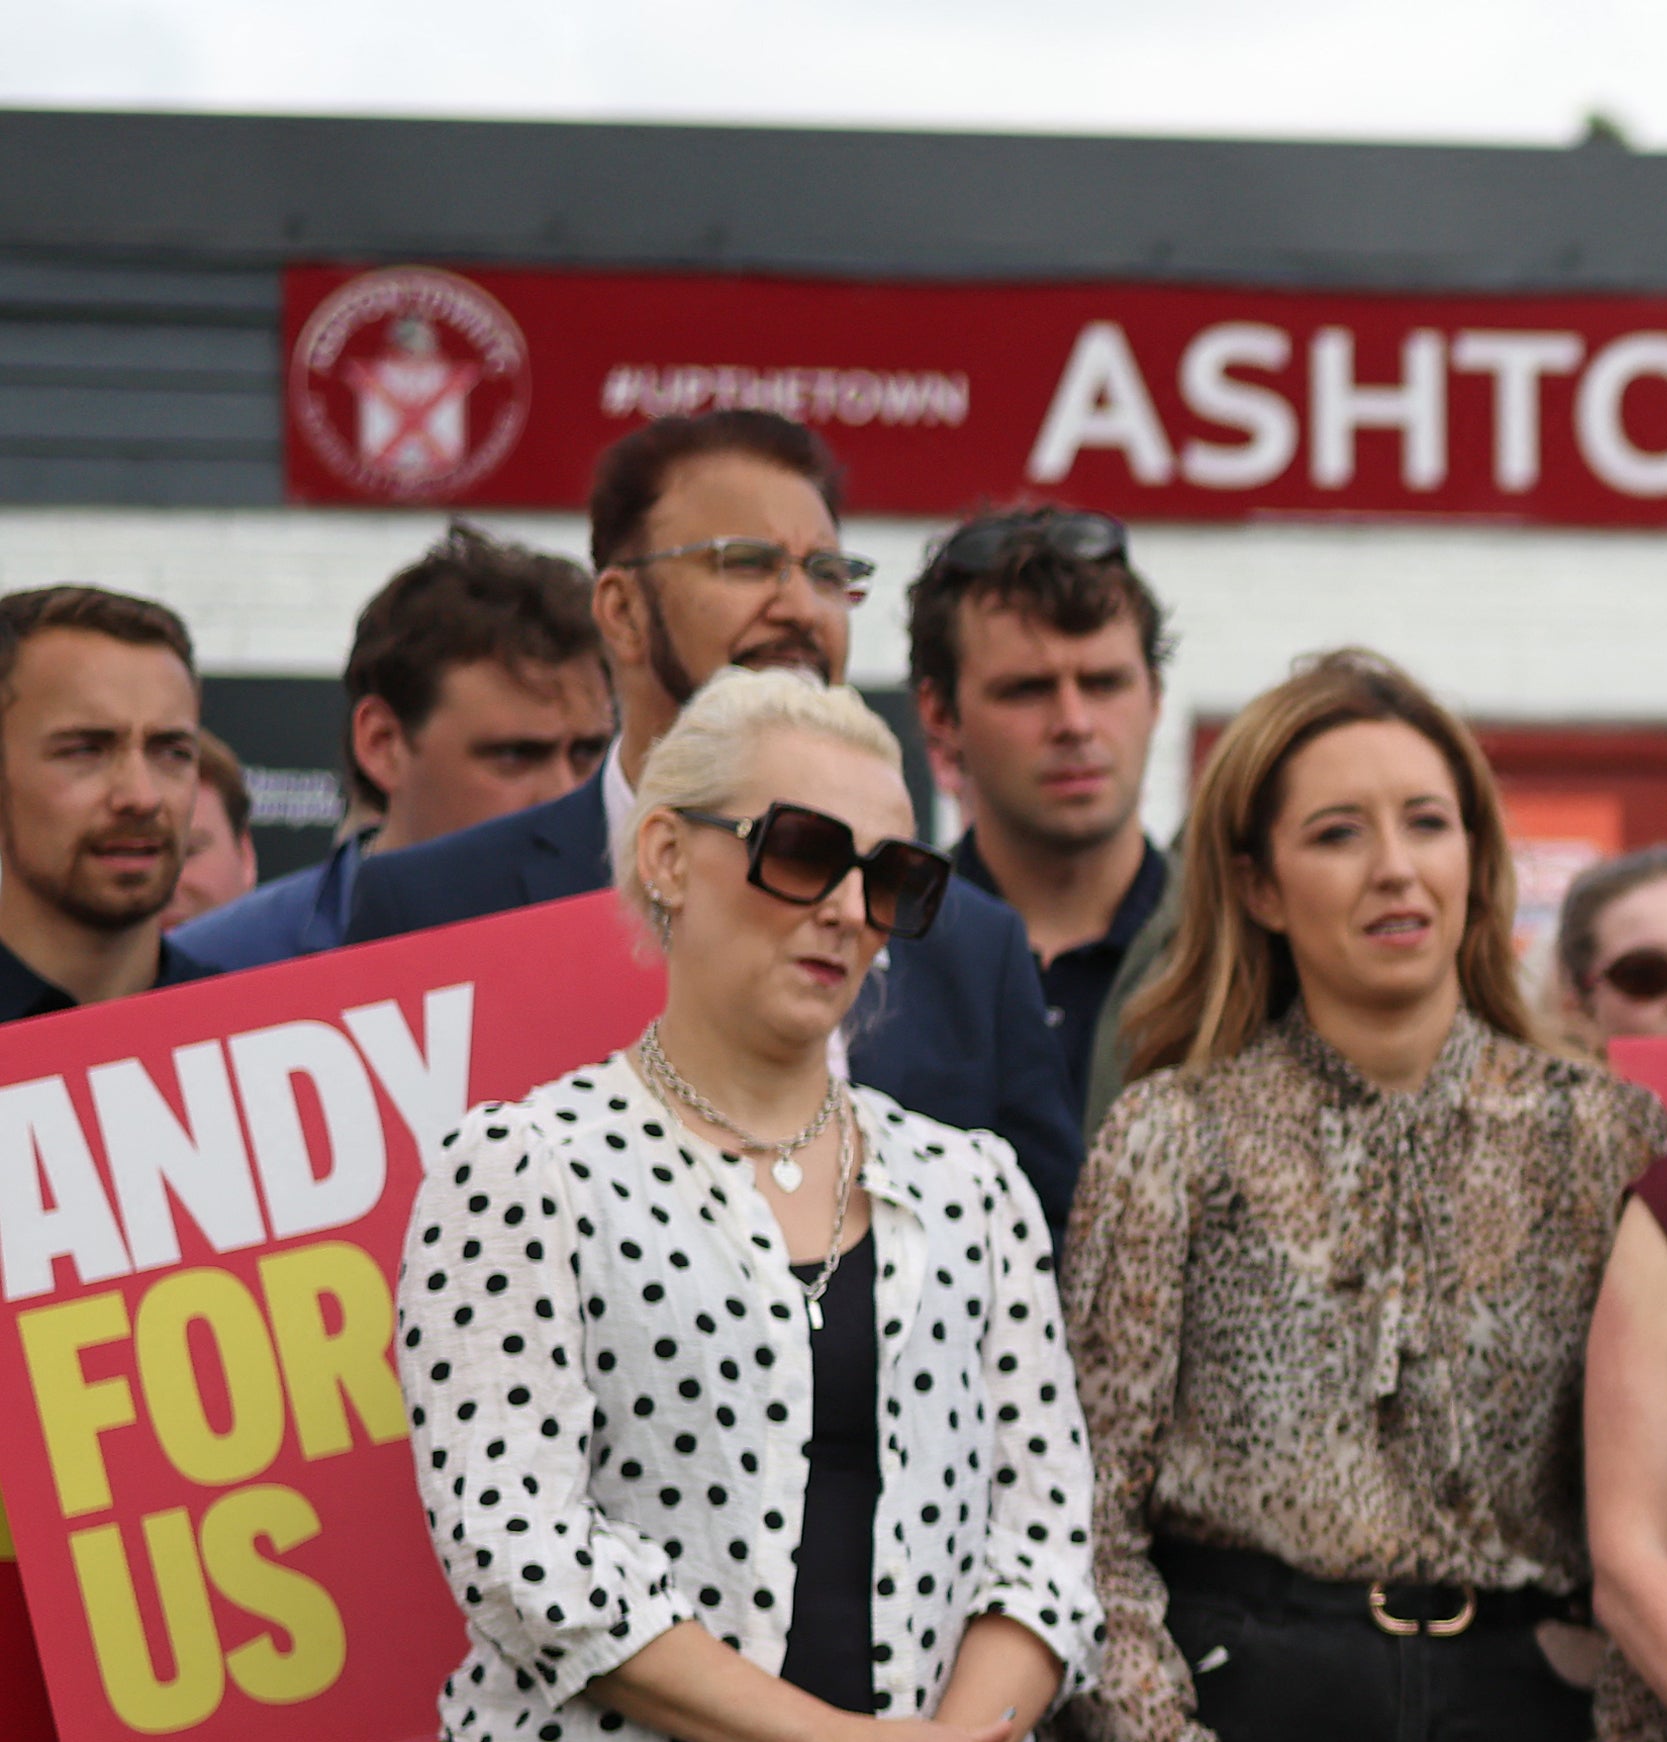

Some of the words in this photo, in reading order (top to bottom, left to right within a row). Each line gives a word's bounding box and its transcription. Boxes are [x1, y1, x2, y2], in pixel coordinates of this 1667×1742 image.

[0, 982, 475, 1302] ANDY
[17, 1240, 411, 1518] FOR
[69, 1483, 347, 1736] US
